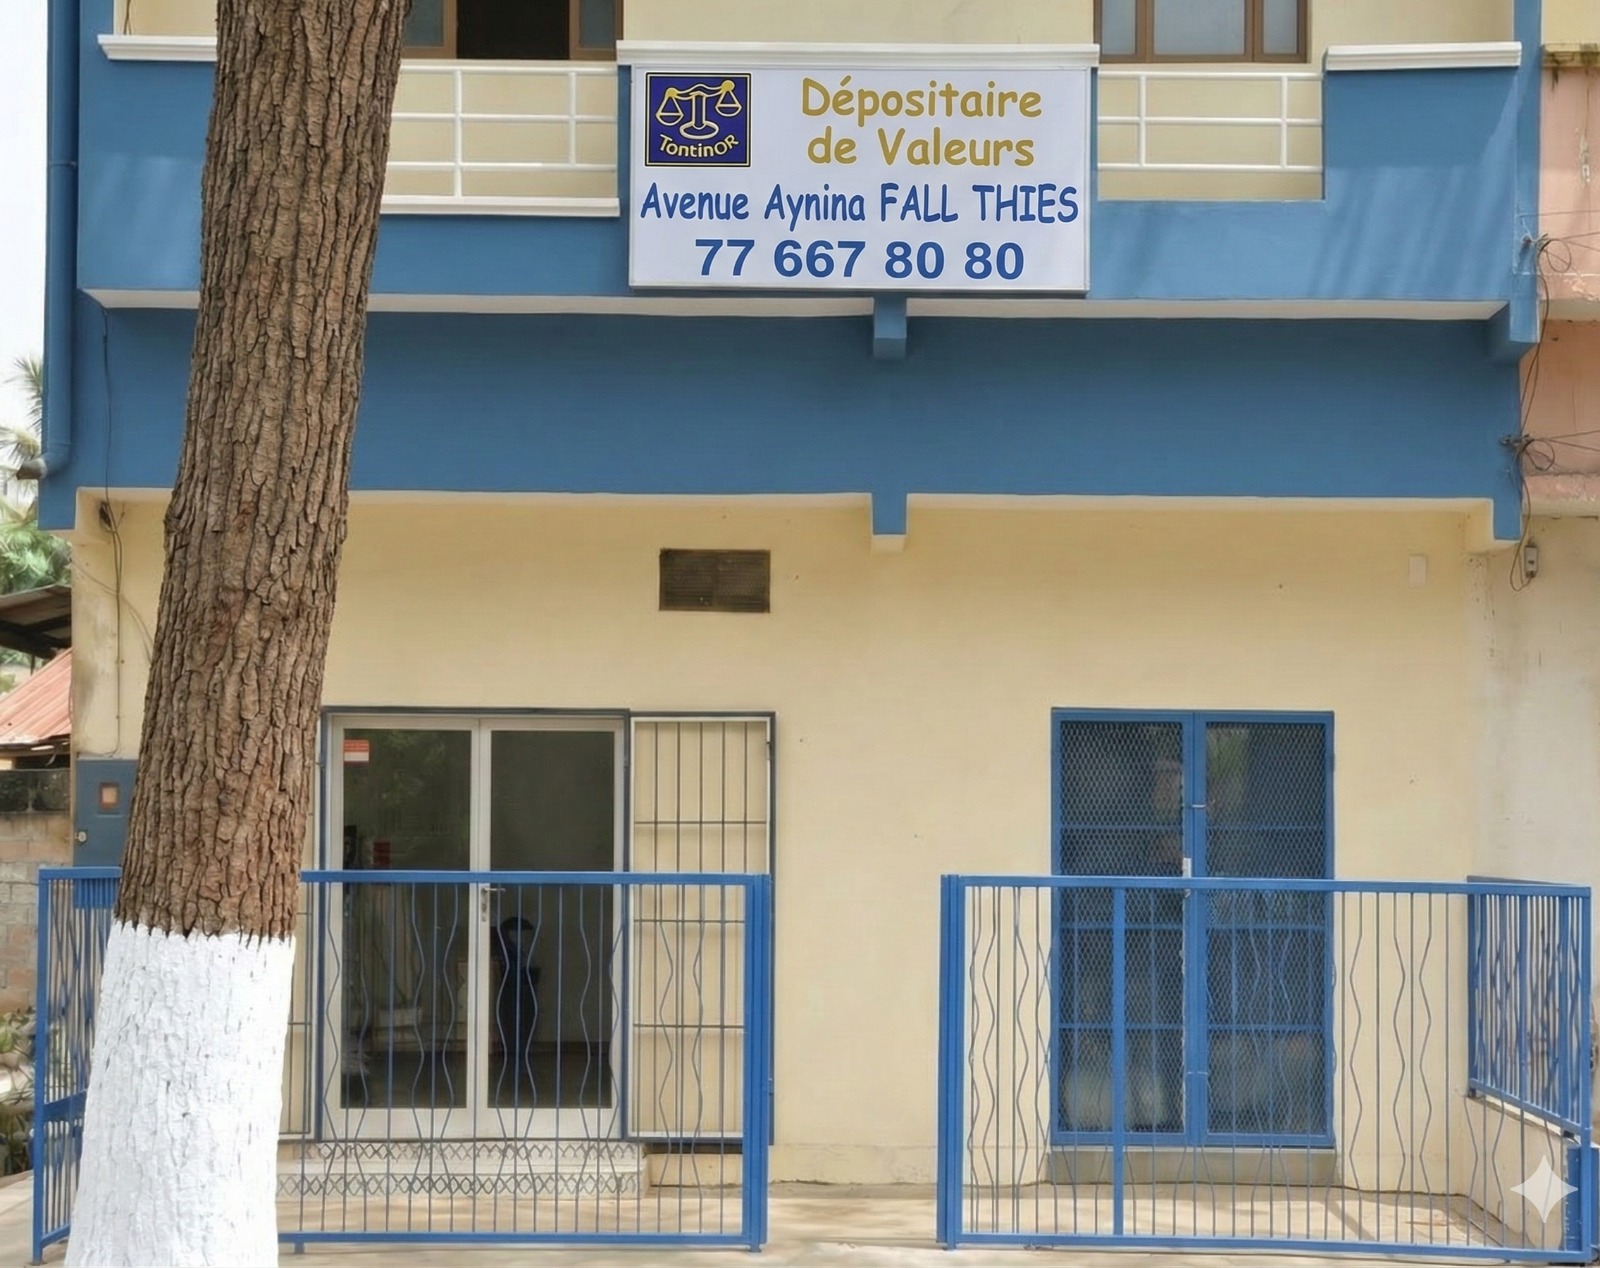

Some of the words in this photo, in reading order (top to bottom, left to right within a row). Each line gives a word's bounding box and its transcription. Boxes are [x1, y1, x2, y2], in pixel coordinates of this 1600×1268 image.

[802, 76, 1041, 127] Dépositaire
[659, 133, 739, 158] TontinOR
[807, 127, 856, 165] de
[877, 127, 1035, 167] Valeurs
[640, 184, 748, 221] Avenue
[764, 185, 865, 230] Aynina
[880, 182, 958, 223] FALL
[973, 182, 1079, 224] THIES
[696, 239, 755, 276] 77
[773, 239, 865, 278] 667
[885, 240, 945, 280] 80
[964, 241, 1025, 281] 80
